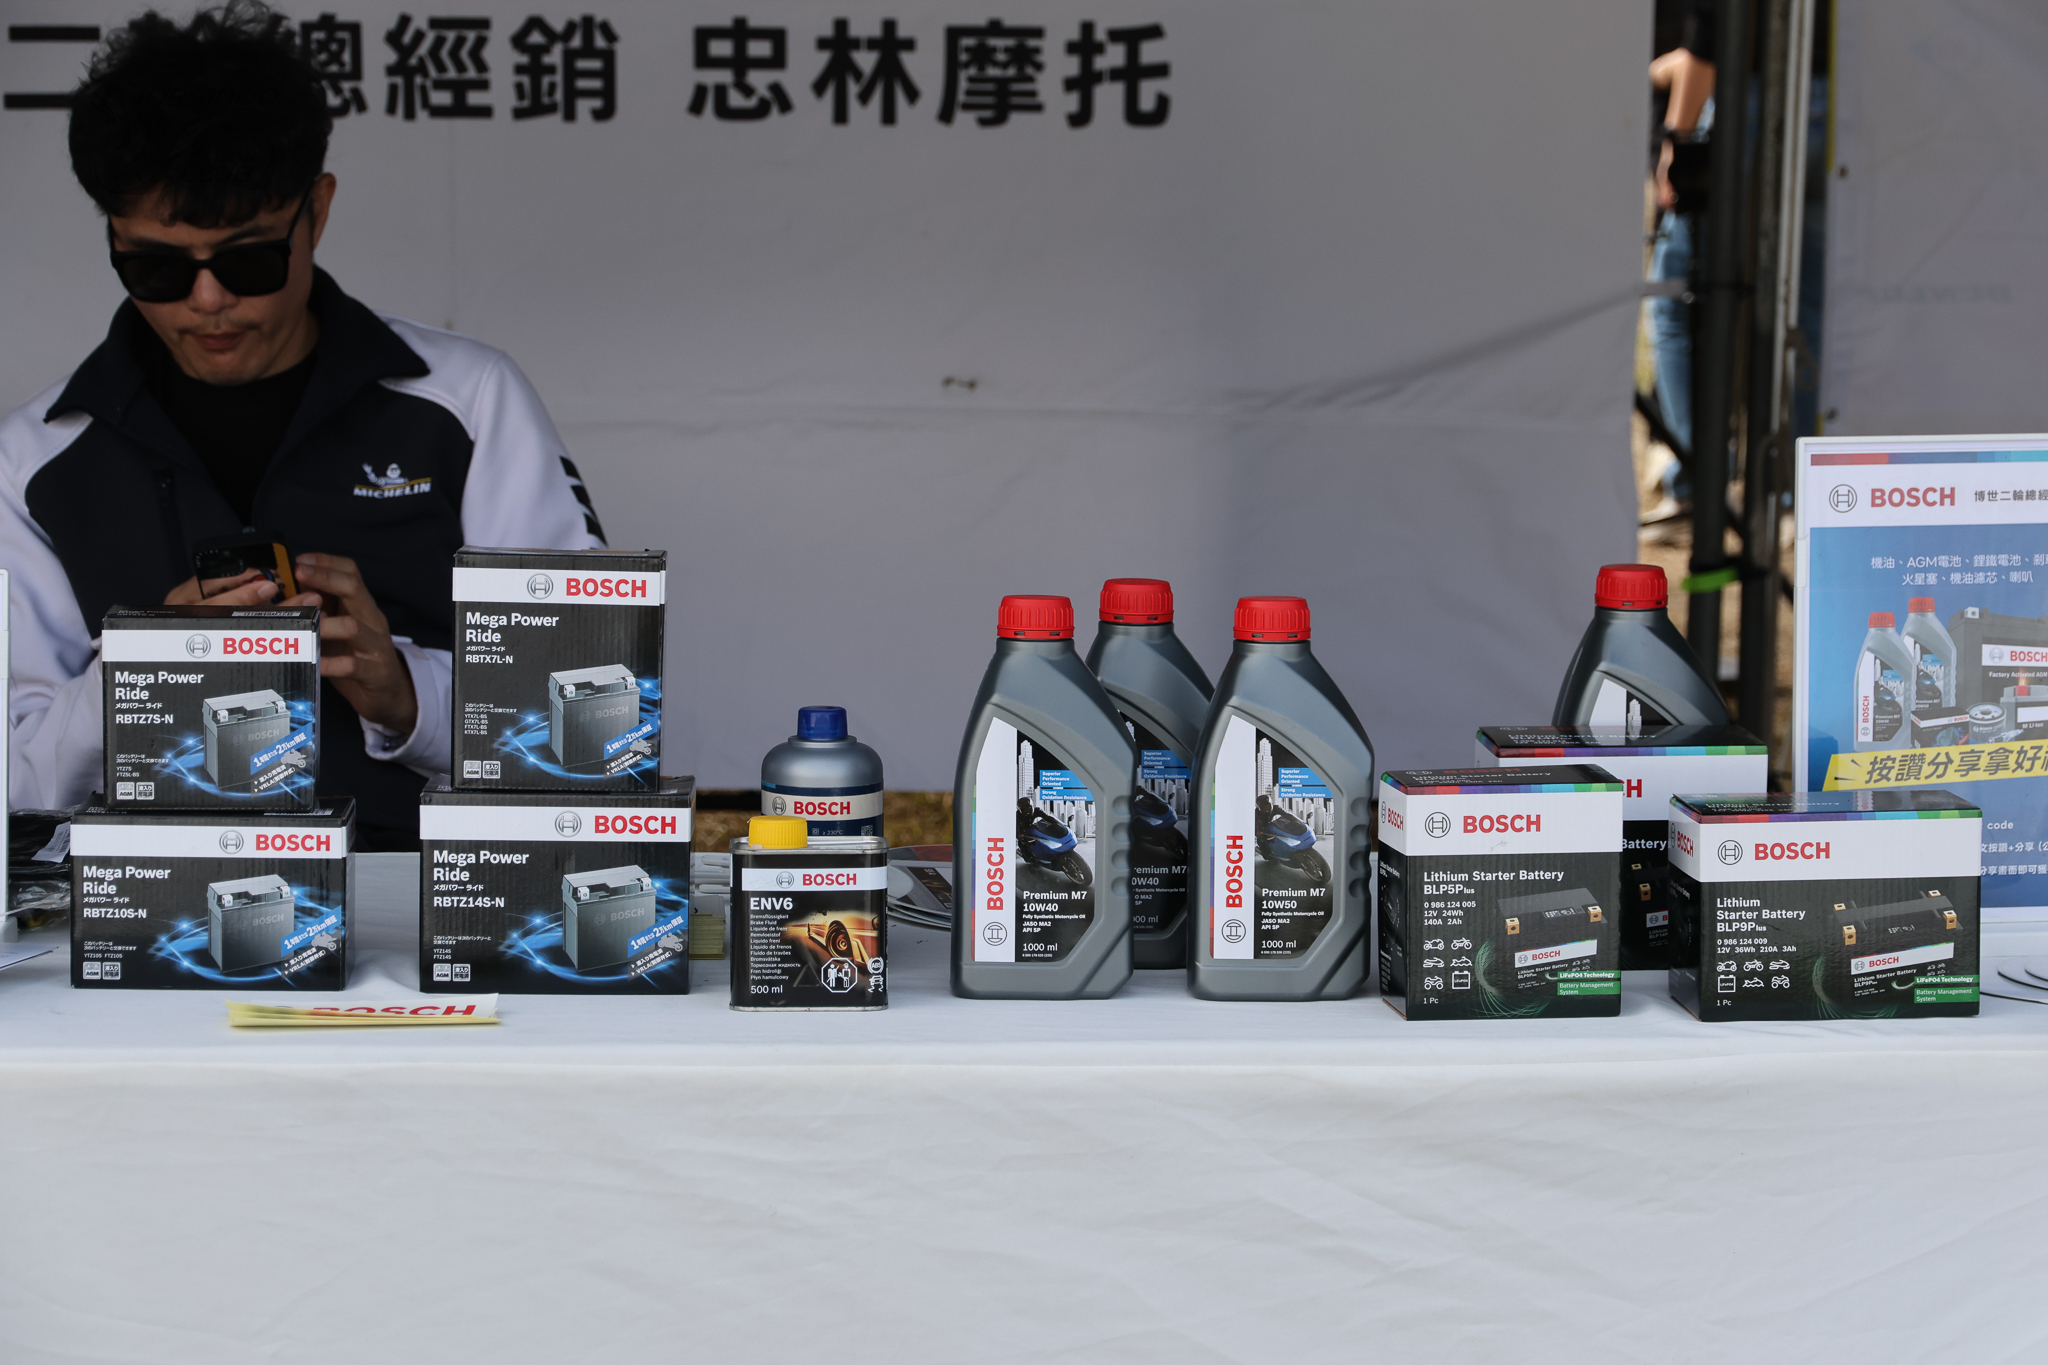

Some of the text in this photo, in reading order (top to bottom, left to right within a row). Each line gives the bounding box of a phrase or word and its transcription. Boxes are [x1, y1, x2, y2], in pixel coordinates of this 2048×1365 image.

[3, 13, 1171, 129] 二總經銷 忠林摩托
[353, 482, 431, 499] MICHELIN
[1870, 487, 1956, 508] BOSCH
[566, 577, 647, 598] BOSCH
[466, 612, 560, 629] Mega Power
[465, 629, 502, 643] Ride
[223, 638, 299, 655] BOSCH
[465, 654, 513, 664] RBTX7L-N
[2010, 650, 2048, 662] BOSCH
[115, 671, 204, 687] Mega Power
[115, 688, 149, 700] Ride
[595, 706, 629, 719] BOSCH
[1862, 695, 1870, 723] BOSCH
[115, 714, 174, 724] RBTZ7S-N
[248, 729, 280, 741] BOSCH
[793, 801, 851, 816] BOSCH
[594, 815, 677, 834] BOSCH
[1387, 807, 1404, 832] BOSCH
[1463, 814, 1541, 834] BOSCH
[1987, 820, 2014, 830] code
[255, 834, 331, 851] BOSCH
[1622, 839, 1667, 851] Battery
[1677, 830, 1694, 857] BOSCH
[1754, 842, 1830, 860] BOSCH
[433, 850, 529, 866] Mega Power
[83, 866, 171, 881] Mega Power
[433, 867, 470, 882] Ride
[987, 837, 1005, 911] BOSCH
[1134, 865, 1187, 874] emium M7
[1226, 835, 1243, 908] BOSCH
[802, 873, 857, 886] BOSCH
[1131, 877, 1159, 886] 0W40
[1423, 870, 1564, 882] Lithium Starter Battery
[83, 881, 117, 895] Ride
[1262, 888, 1326, 897] Premium M7
[1423, 884, 1475, 895] BLP5Plus
[1023, 890, 1088, 900] Premium M7
[433, 897, 505, 908] RBTZ14S-N
[750, 897, 793, 910] ENV6
[1023, 902, 1059, 912] 10W40
[1261, 900, 1297, 909] 10W50
[1717, 897, 1760, 908] Lithium
[83, 908, 147, 919] RBTZ10S-N
[610, 907, 645, 921] BOSCH
[1716, 909, 1806, 920] Starter Battery
[252, 913, 285, 927] BOSCH
[1717, 922, 1767, 932] BLP9Plus
[1023, 943, 1058, 952] 1000 ml
[1261, 940, 1297, 949] 1000 ml
[1531, 950, 1561, 961] BOSCH
[871, 961, 882, 969] ABS
[1869, 956, 1900, 968] BOSCH
[1876, 972, 1896, 980] Starter
[1896, 968, 1917, 976] Battery
[750, 984, 783, 994] 500 ml
[1937, 988, 1973, 996] Management
